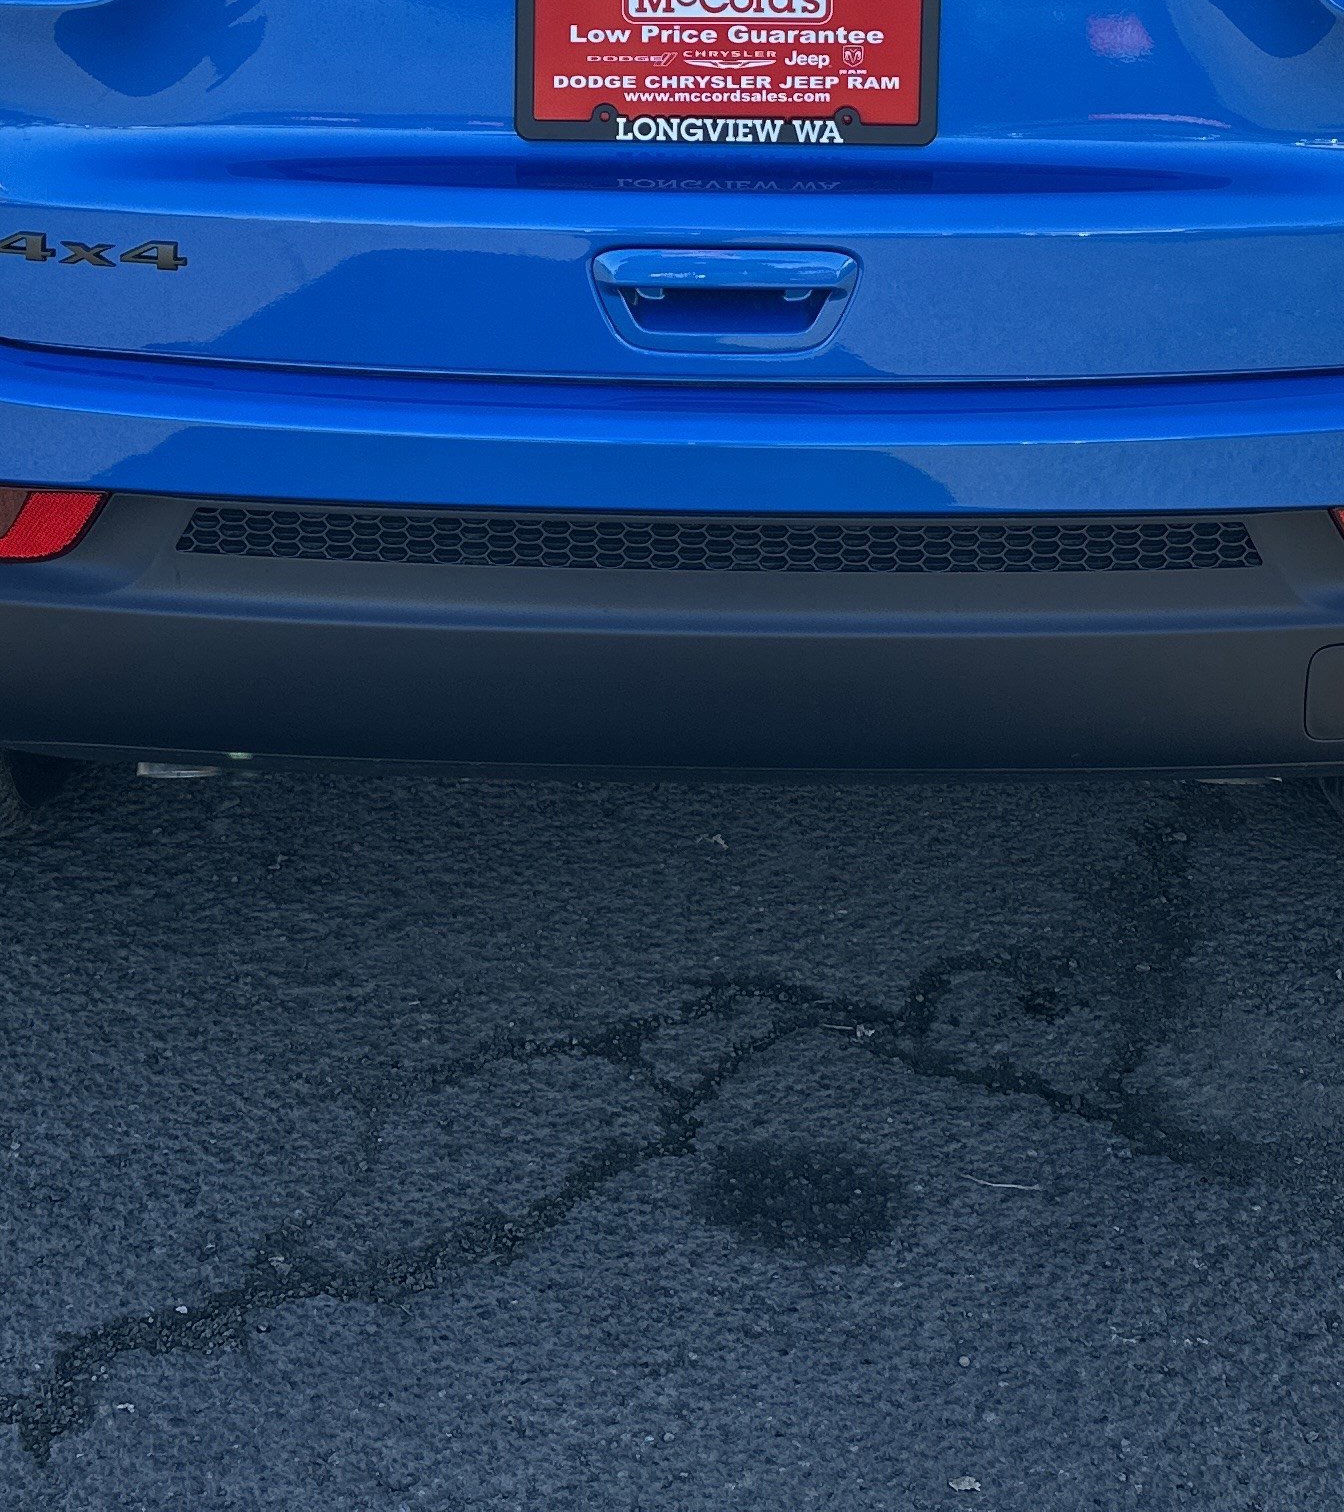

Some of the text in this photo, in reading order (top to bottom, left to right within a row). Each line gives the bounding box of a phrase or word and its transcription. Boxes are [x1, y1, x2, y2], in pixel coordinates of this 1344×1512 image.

[569, 24, 885, 45] Low Price Guarantee
[586, 54, 665, 63] DODGE
[682, 50, 777, 58] CHRYSLER
[784, 50, 831, 69] Jeep
[553, 75, 900, 90] DODGE CHRYSLER JEEP RAM
[624, 90, 831, 103] www.mccordsales.com
[615, 117, 844, 144] LONGVIEW WA
